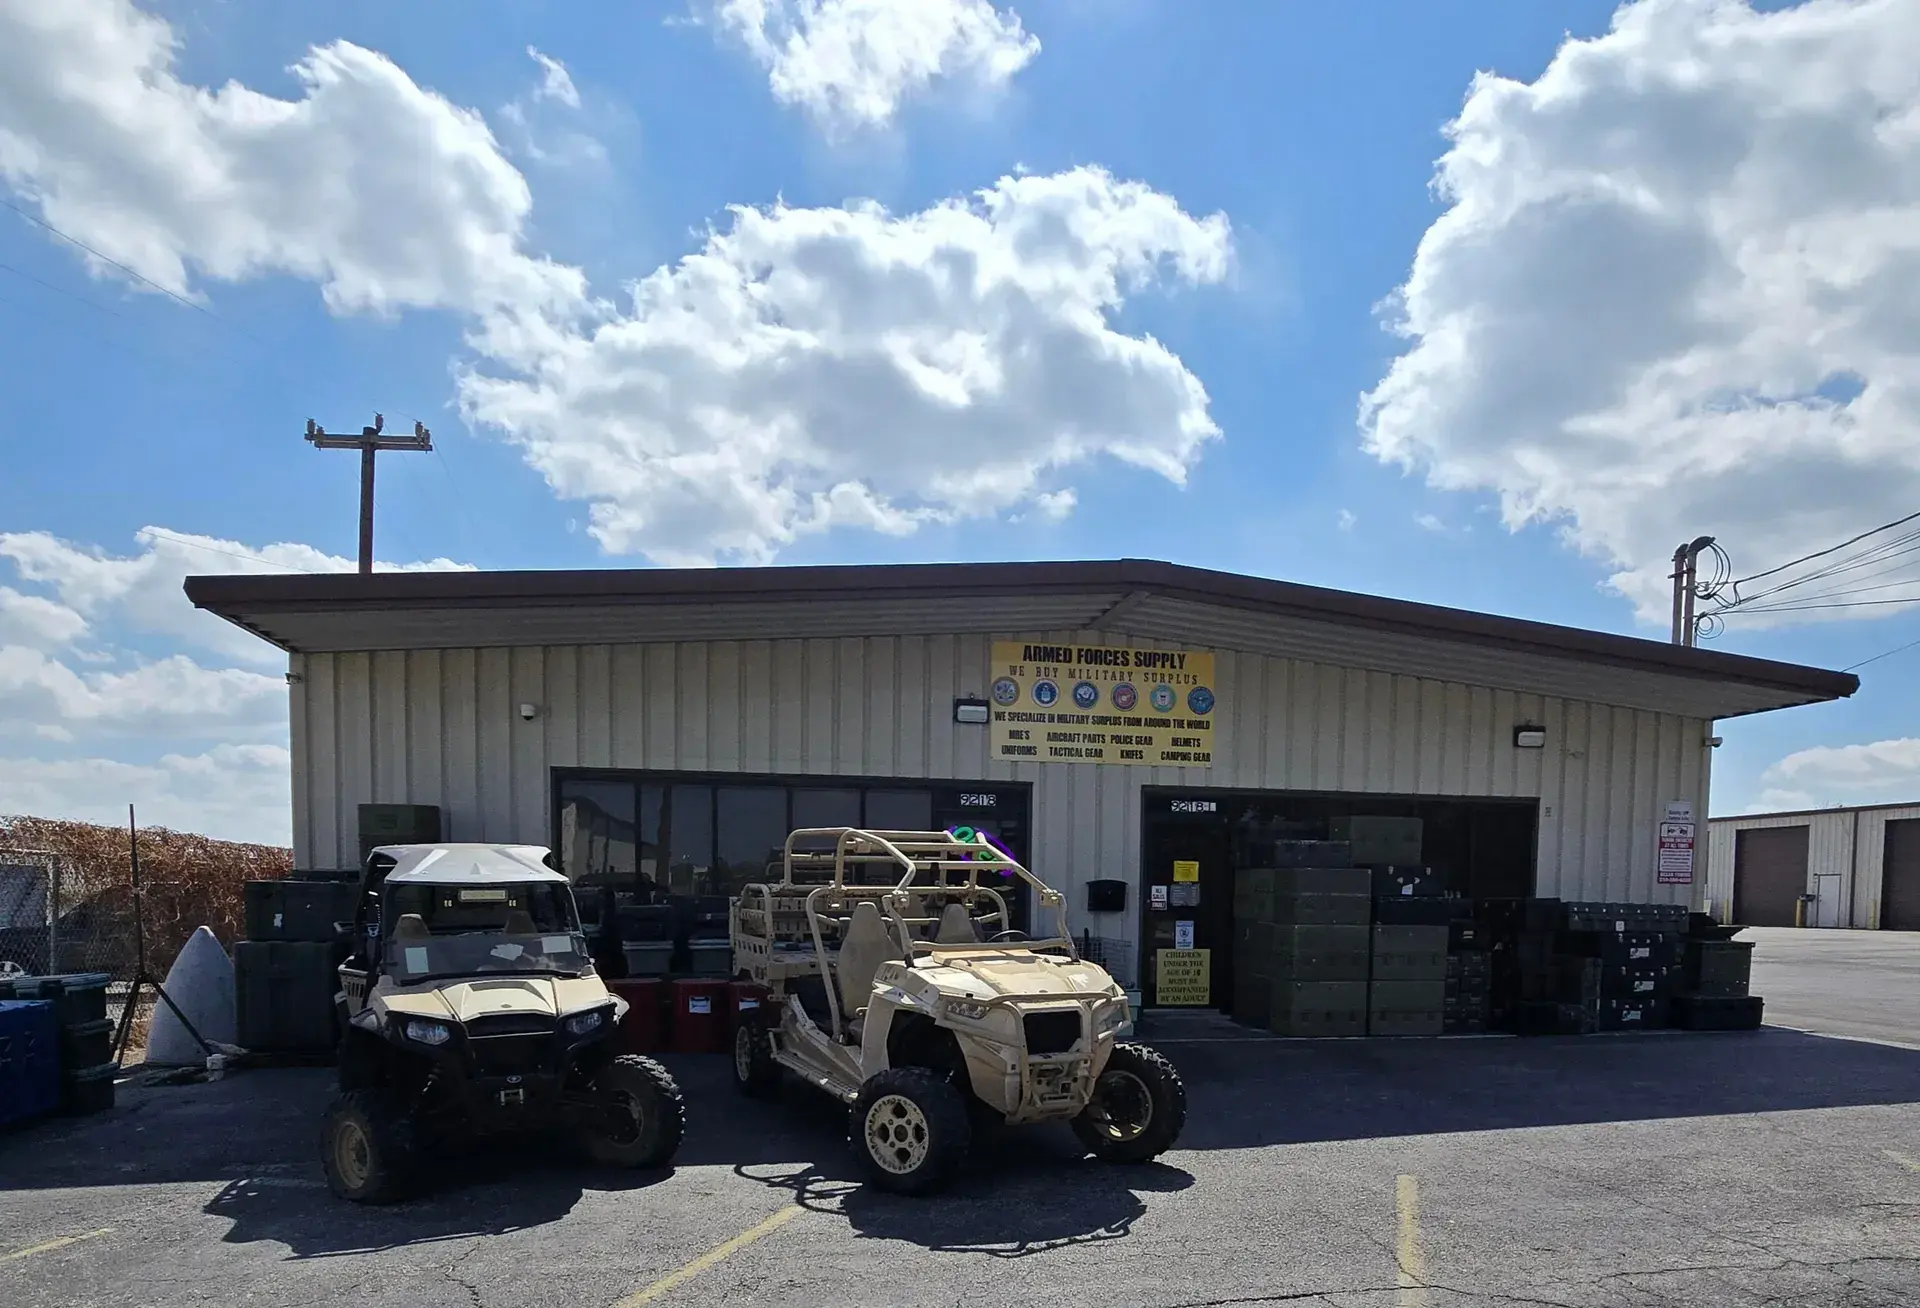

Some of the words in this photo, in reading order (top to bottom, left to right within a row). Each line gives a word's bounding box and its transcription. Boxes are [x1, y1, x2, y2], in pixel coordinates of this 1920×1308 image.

[1023, 645, 1072, 663] ARMED
[1077, 648, 1130, 667] FORCES
[1134, 651, 1187, 669] SUPPLY
[1009, 665, 1025, 676] WE
[1036, 667, 1058, 678] BUY
[1068, 668, 1133, 682] MILITARY
[1143, 672, 1198, 685] SURPLUS
[994, 711, 1006, 721] WE
[1008, 712, 1046, 723] SPECIALIZE
[1057, 714, 1090, 725] MILITARY
[1091, 715, 1122, 726] SURPLUS
[1123, 716, 1142, 727] FROM
[1144, 717, 1171, 728] AROUND
[1173, 719, 1185, 729] THE
[1187, 719, 1210, 730] WORLD
[1047, 732, 1080, 743] AIRCRAFT
[1082, 733, 1106, 744] PARTS
[1110, 734, 1134, 745] POLICE
[1135, 735, 1153, 746] GEAR
[1171, 737, 1201, 748] HELMETS
[1001, 745, 1037, 756] UNIFORMS
[1049, 747, 1083, 758] TACTICAL
[1085, 748, 1103, 758] GEAR
[1120, 749, 1144, 760] KNIFES
[1160, 751, 1192, 762] CAMPING
[1193, 752, 1211, 762] GEAR
[960, 793, 997, 807] 9218
[1165, 951, 1202, 959] CHILDREN
